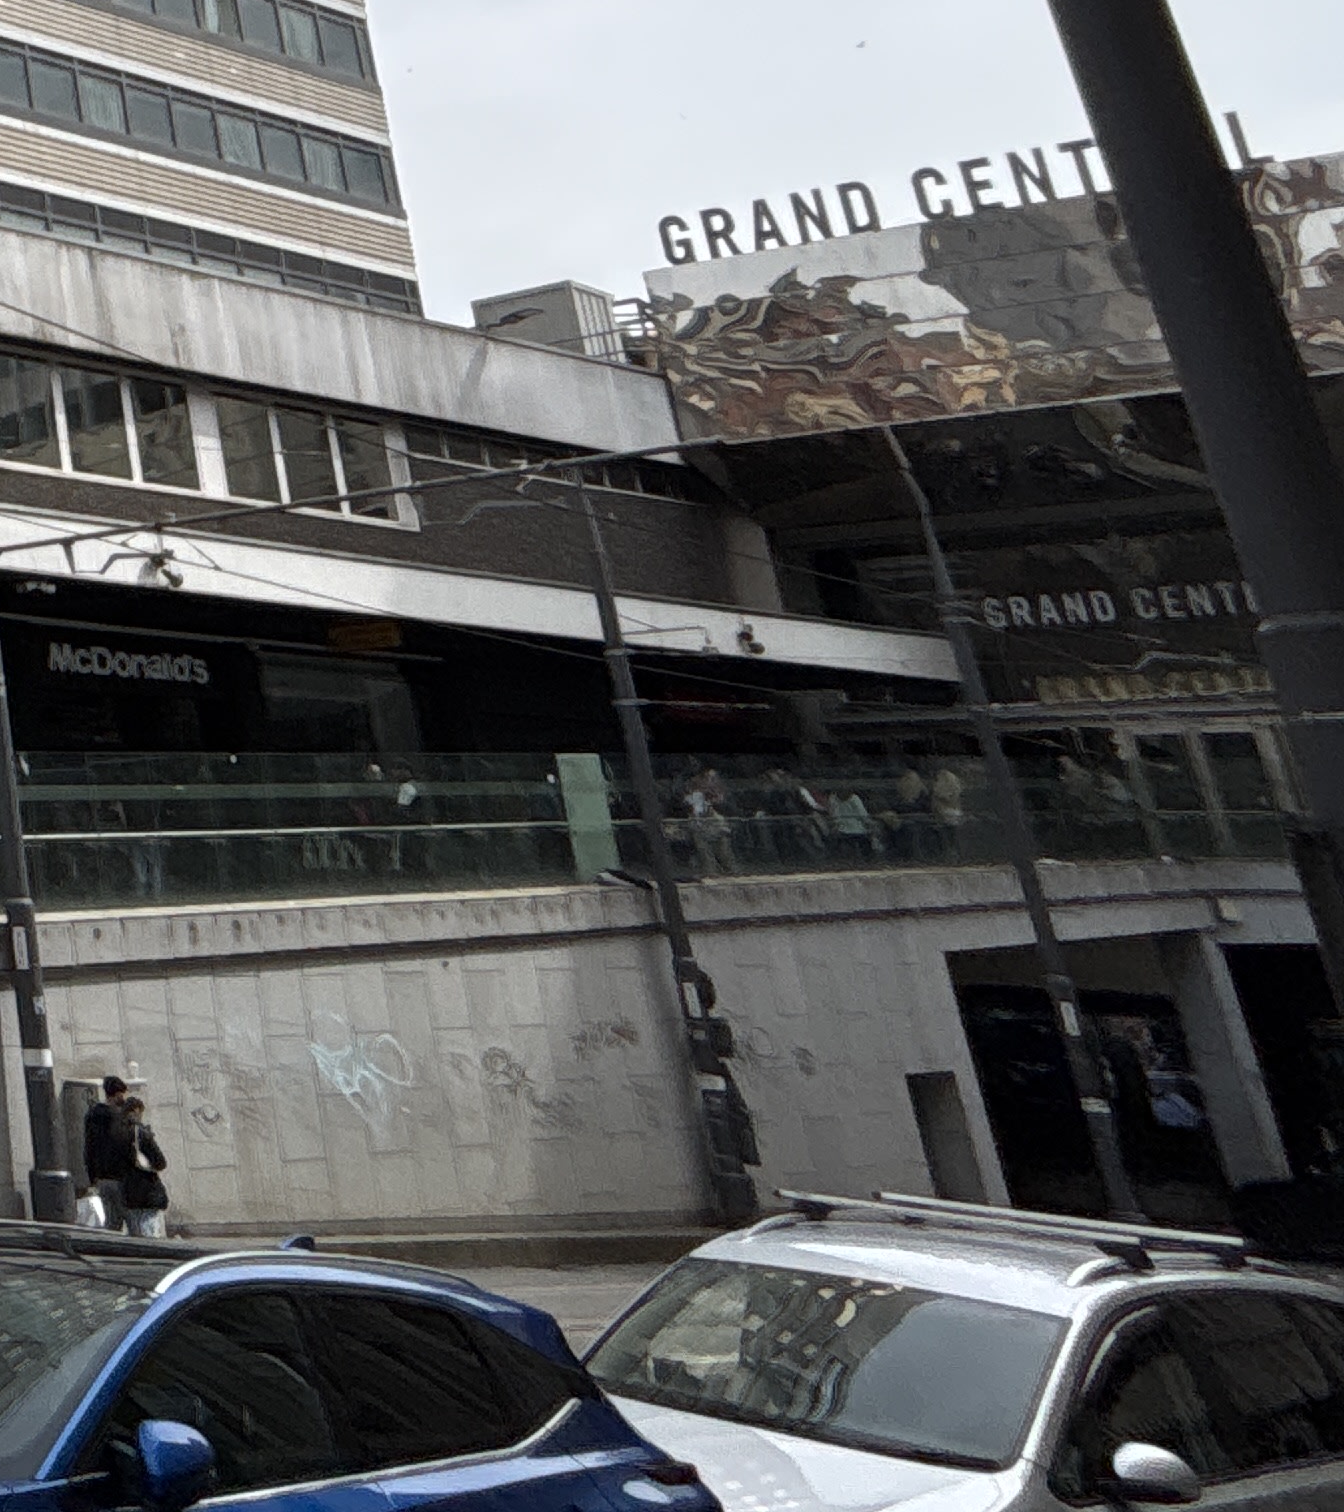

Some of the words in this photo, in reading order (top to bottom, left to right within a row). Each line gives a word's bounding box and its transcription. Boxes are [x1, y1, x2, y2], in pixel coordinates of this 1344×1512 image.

[658, 180, 882, 266] GRAND
[910, 110, 1274, 222] CENTL
[981, 589, 1118, 630] GRAND
